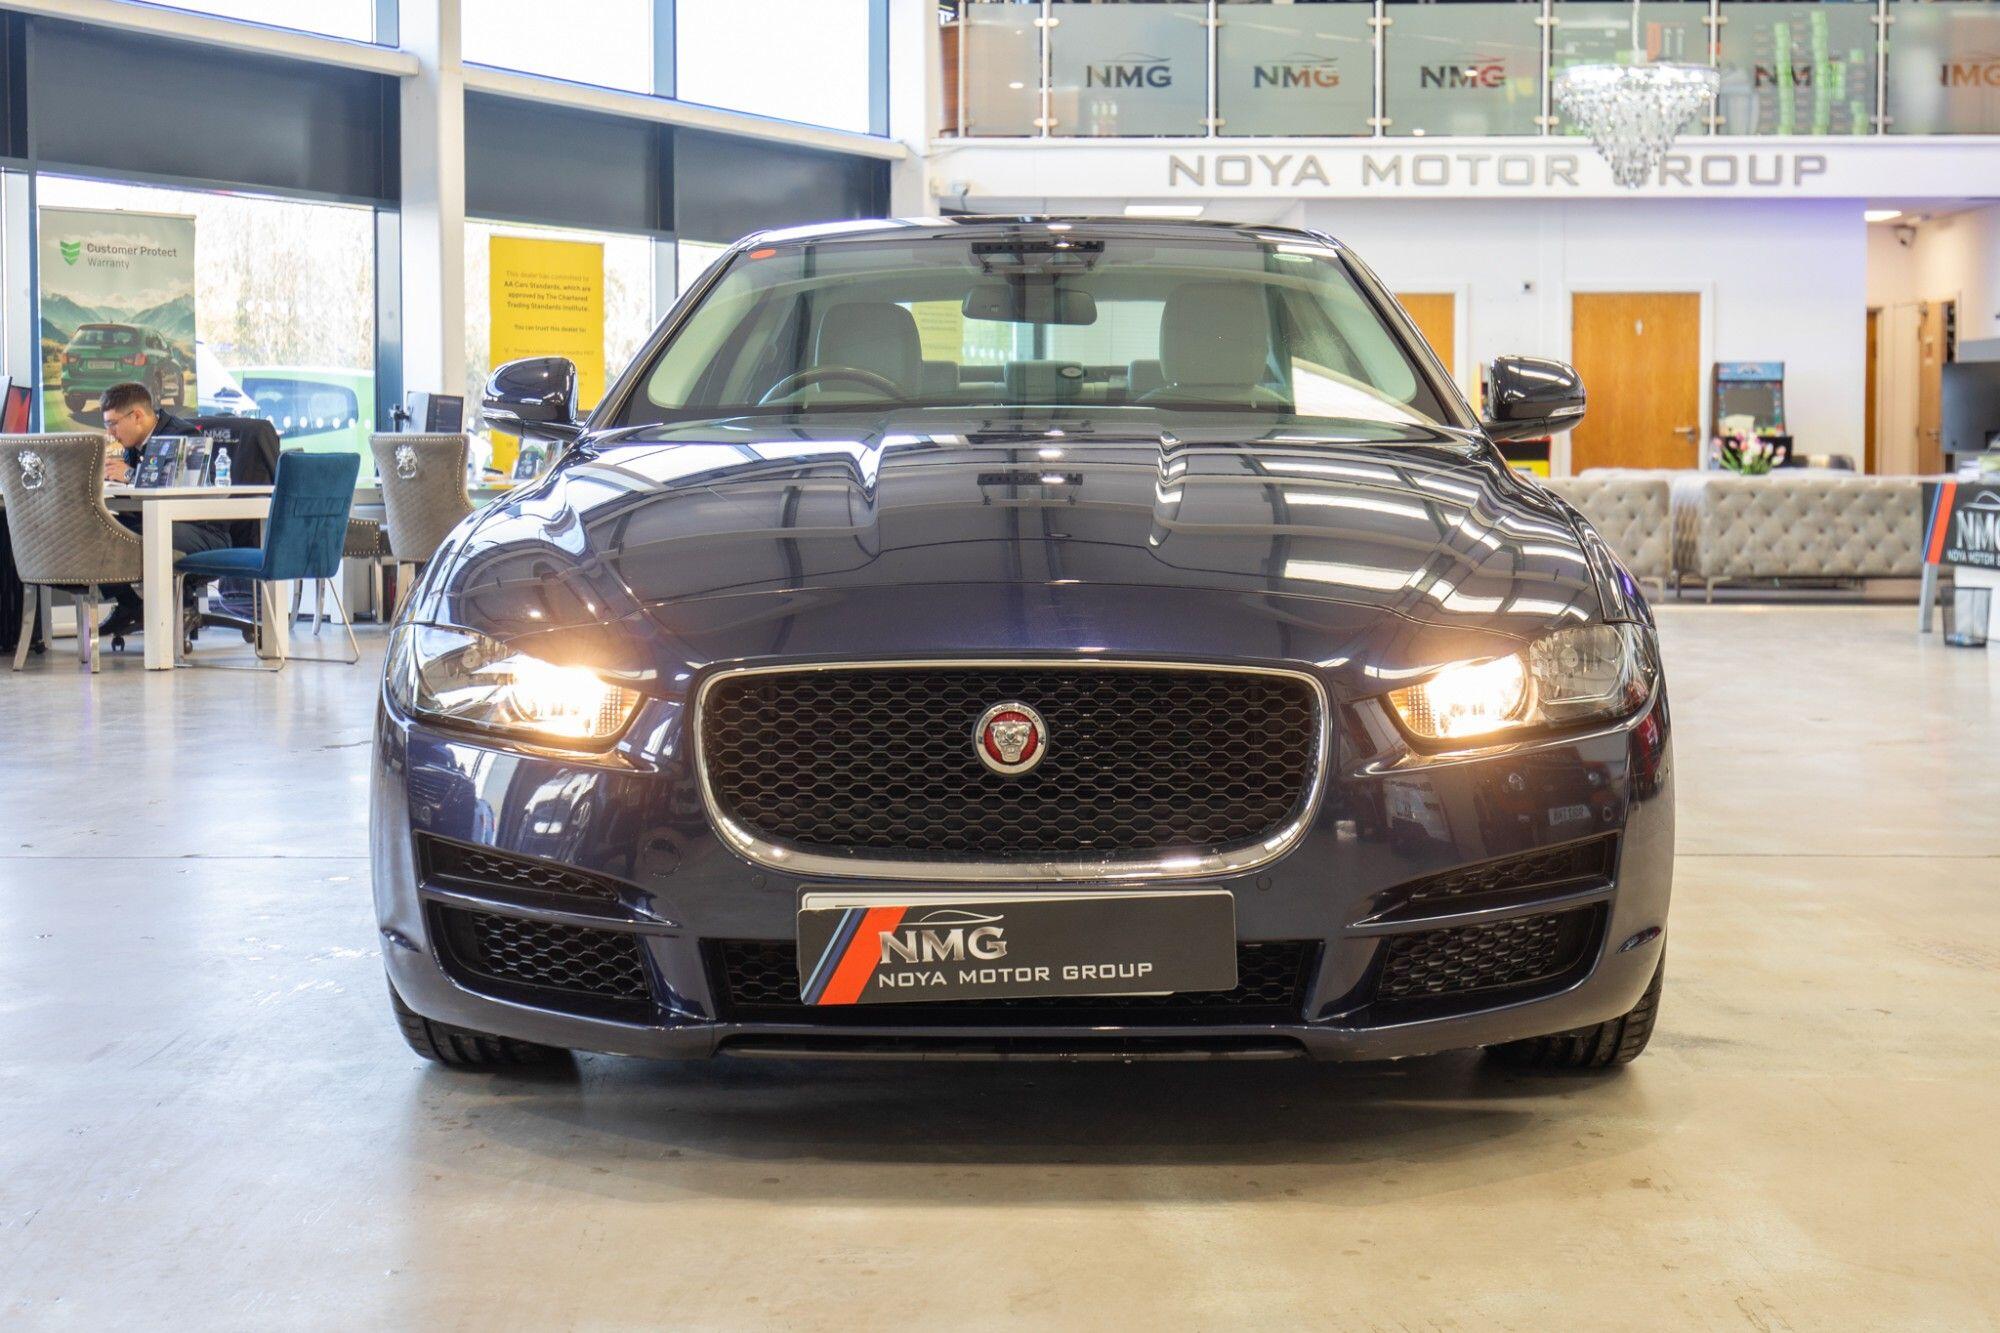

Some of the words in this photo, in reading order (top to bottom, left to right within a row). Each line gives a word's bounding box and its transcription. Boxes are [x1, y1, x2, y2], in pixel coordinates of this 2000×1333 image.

[1086, 65, 1172, 88] NMG
[1253, 65, 1340, 88] NMG
[1420, 65, 1506, 88] NMG
[1169, 154, 1331, 186] NOYA
[1362, 154, 1580, 186] MOTOR
[86, 243, 138, 256] Customer
[140, 246, 178, 258] Protect
[87, 257, 130, 270] Warranty
[1955, 510, 2000, 552] NM
[878, 926, 1008, 965] NMG
[878, 970, 947, 988] NOYA
[959, 966, 1050, 985] MOTOR
[1062, 962, 1153, 981] GROUP
